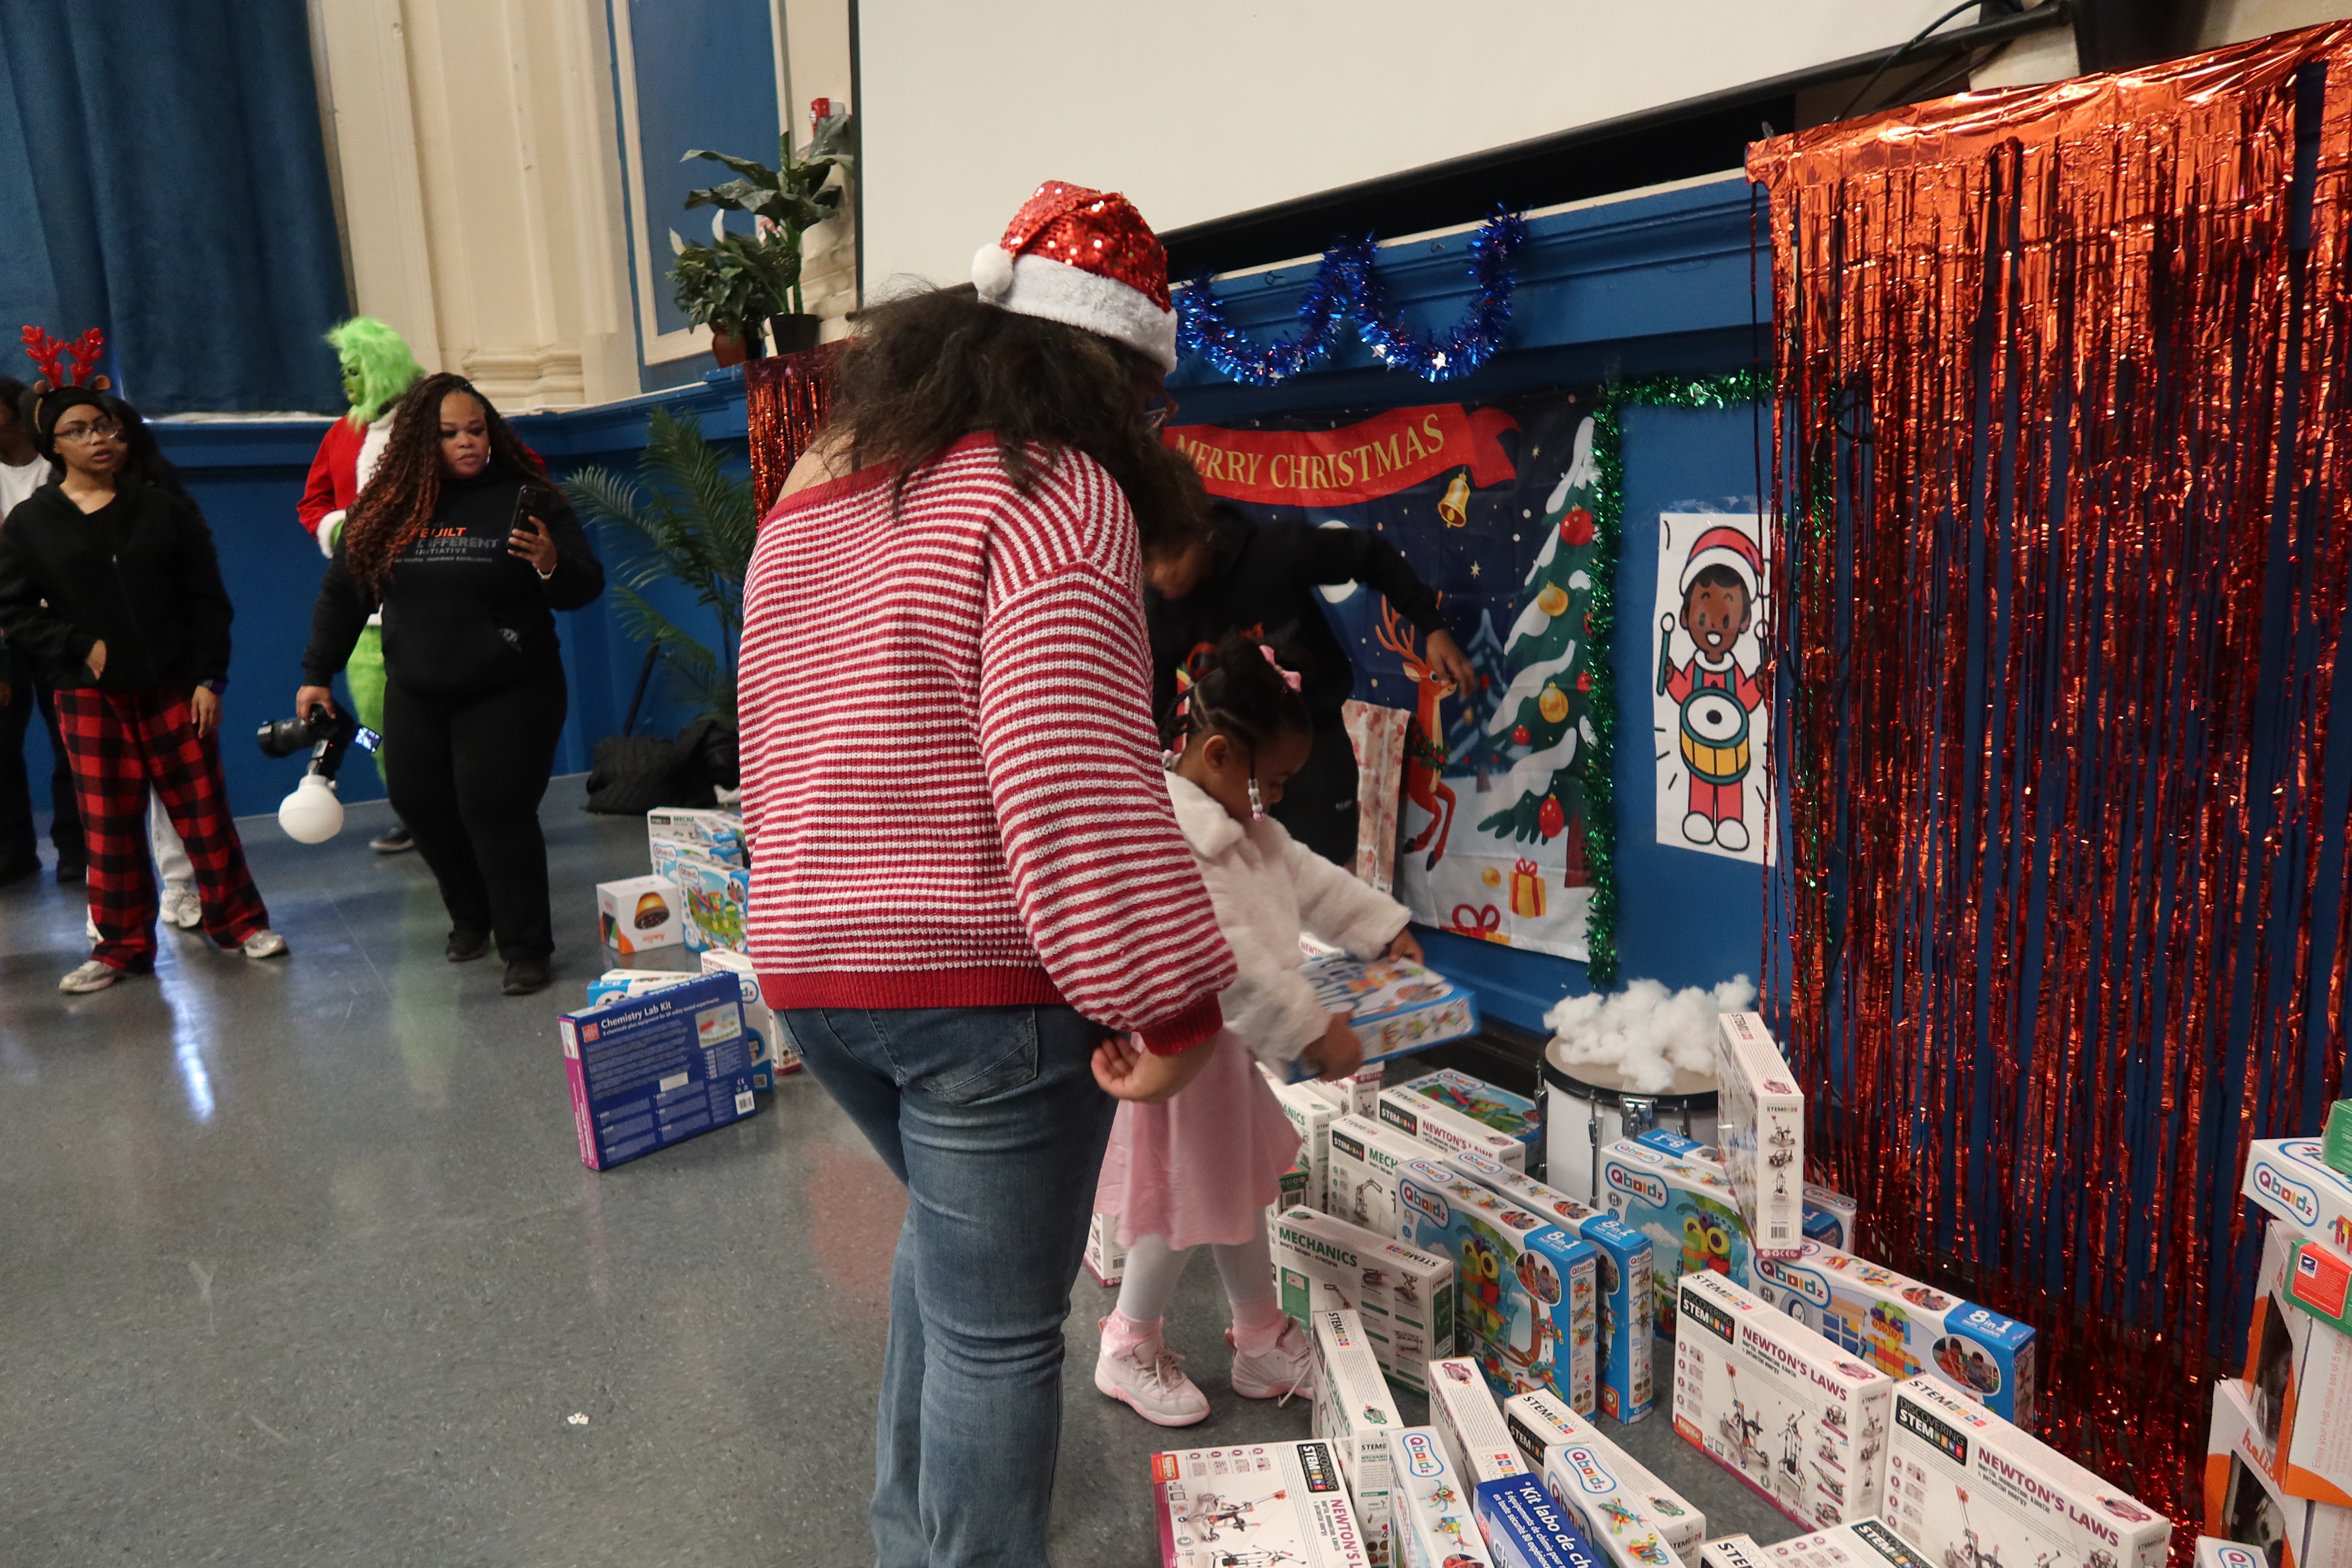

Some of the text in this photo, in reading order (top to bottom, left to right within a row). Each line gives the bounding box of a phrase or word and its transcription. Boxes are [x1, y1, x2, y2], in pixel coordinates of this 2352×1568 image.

[1176, 413, 1445, 490] MERRY CHRISTMAS
[600, 1001, 672, 1029] Chemistry Lab Kit
[1283, 1104, 1305, 1126] ANICS
[1381, 1108, 1400, 1124] STEM
[1334, 1137, 1350, 1151] STEM
[1422, 1120, 1467, 1150] NEWTON'S
[1611, 1169, 1663, 1200] Qboidz
[2259, 1170, 2312, 1218] Qboidz
[1279, 1226, 1357, 1268] MECHANICS
[1693, 1274, 1726, 1295] STEM
[1761, 1260, 1824, 1299] Qboidz
[1328, 1312, 1344, 1331] STEM
[1683, 1289, 1732, 1326] DISCOVERING
[1683, 1298, 1709, 1323] STEM
[1743, 1325, 1847, 1401] NEWTON'S LAWS
[1523, 1396, 1553, 1418] STEM
[1908, 1380, 1952, 1407] STEM
[1510, 1425, 1531, 1450] STEM
[1899, 1408, 1934, 1440] STEM
[1900, 1398, 1964, 1446] DISCOVERING
[1302, 1446, 1321, 1470] STEM
[1315, 1444, 1339, 1490] DISCOVERING
[1410, 1437, 1434, 1473] Qboidz
[1572, 1452, 1606, 1490] Qboidz
[1978, 1446, 2119, 1547] NEWTON'S LAWS
[1330, 1499, 1361, 1560] NEWTON'S
[1519, 1486, 1593, 1568] Kit labo de ch
[1858, 1525, 1896, 1554] STEM
